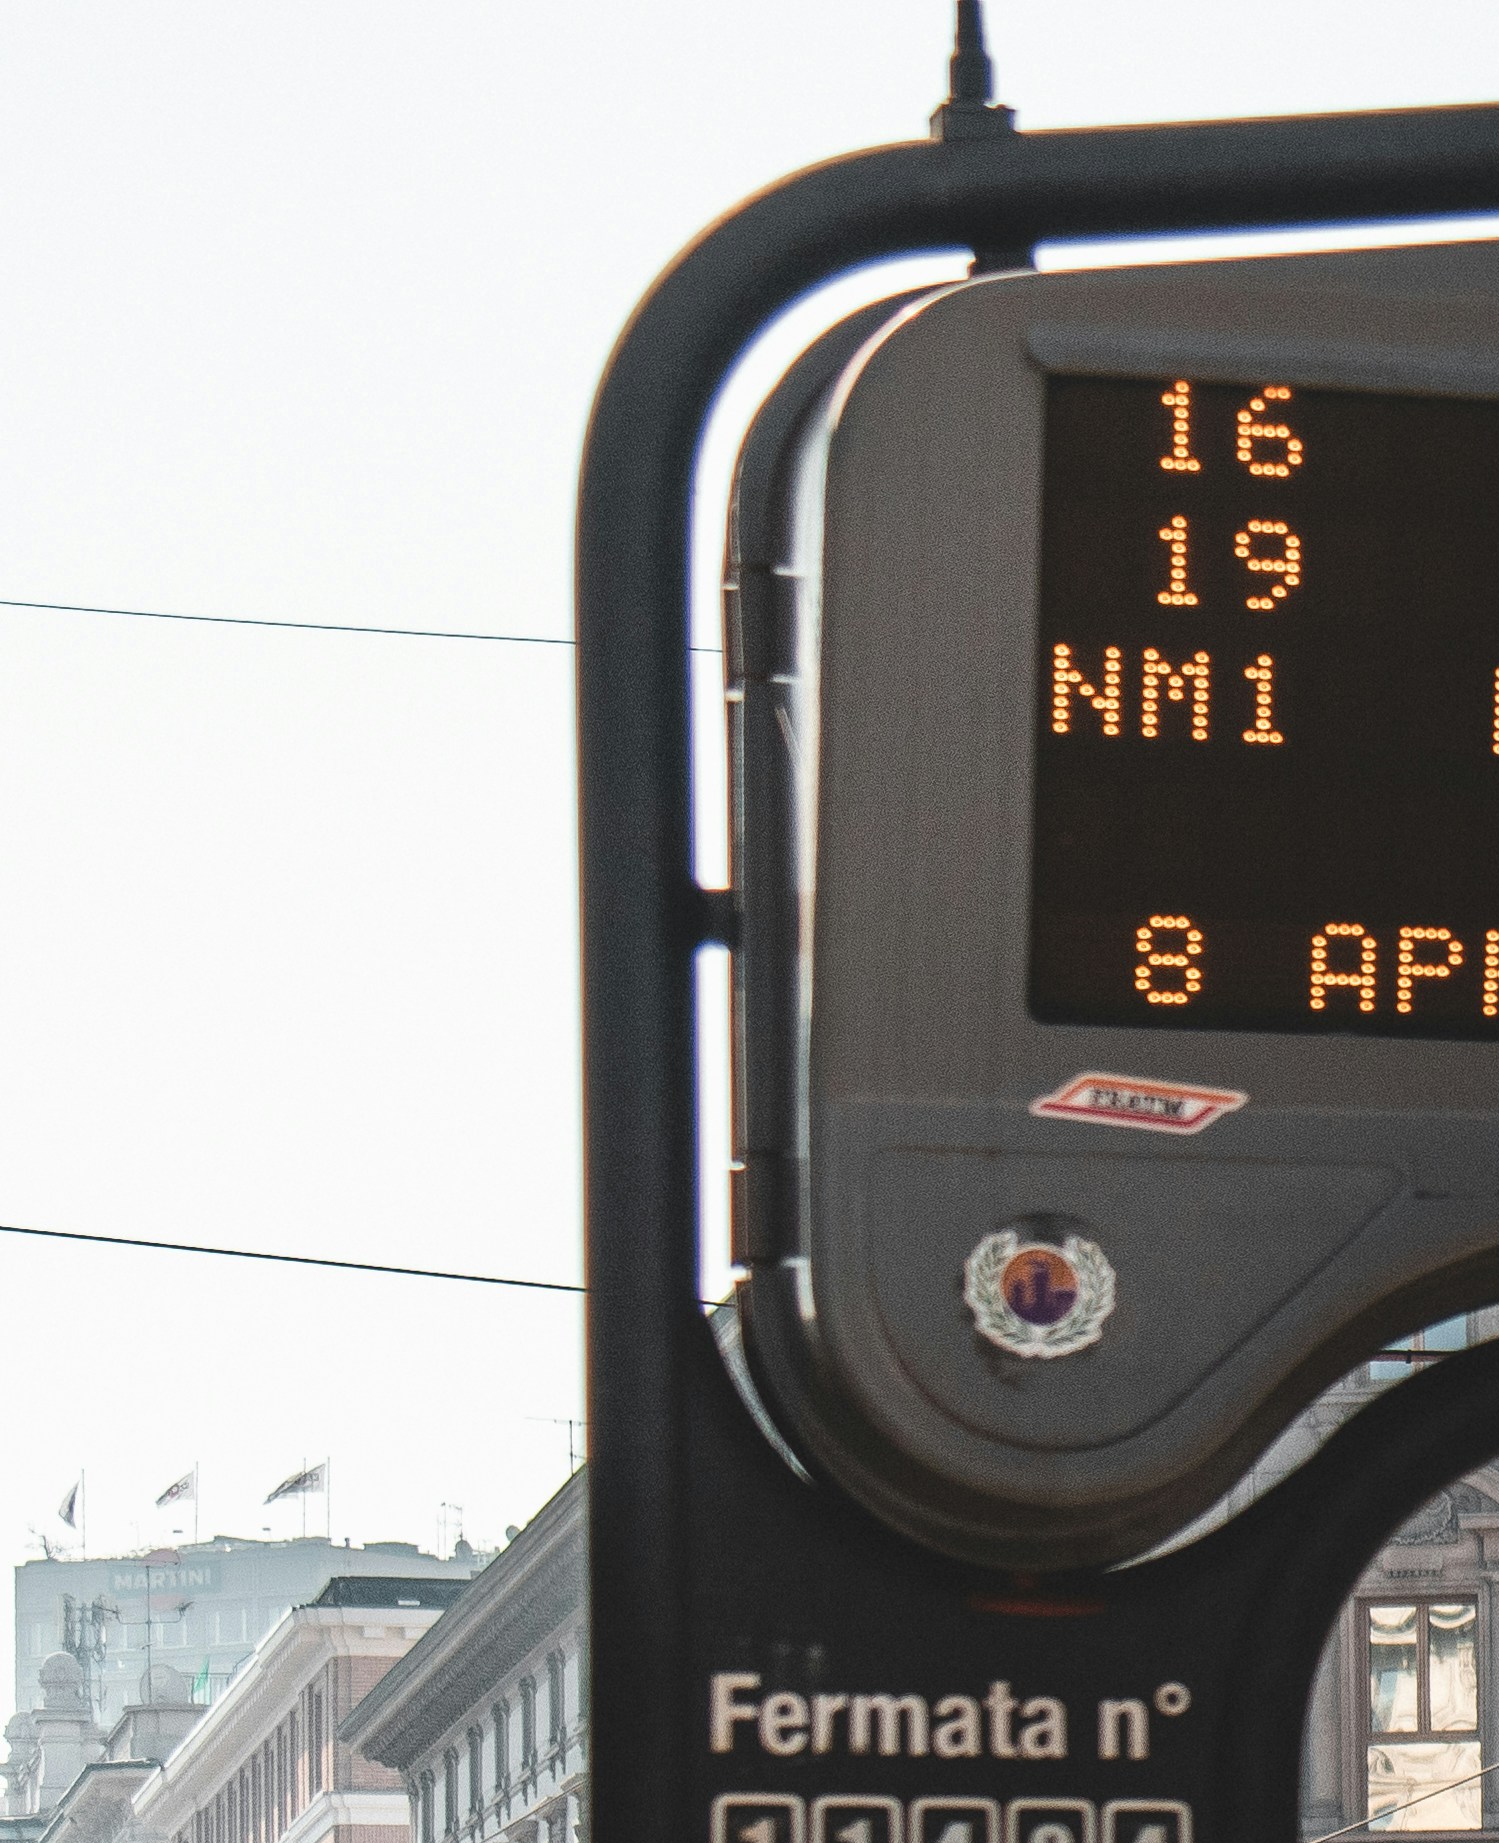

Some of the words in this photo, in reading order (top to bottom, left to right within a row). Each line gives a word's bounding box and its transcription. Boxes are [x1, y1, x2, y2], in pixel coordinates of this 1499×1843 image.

[1157, 380, 1305, 478] 16
[1155, 514, 1303, 610] 19
[1050, 642, 1286, 745] NM1
[1135, 914, 1204, 1007] 8
[113, 1567, 212, 1591] MARTINI
[708, 1672, 1069, 1760] Fermata
[1098, 1680, 1192, 1760] n°
